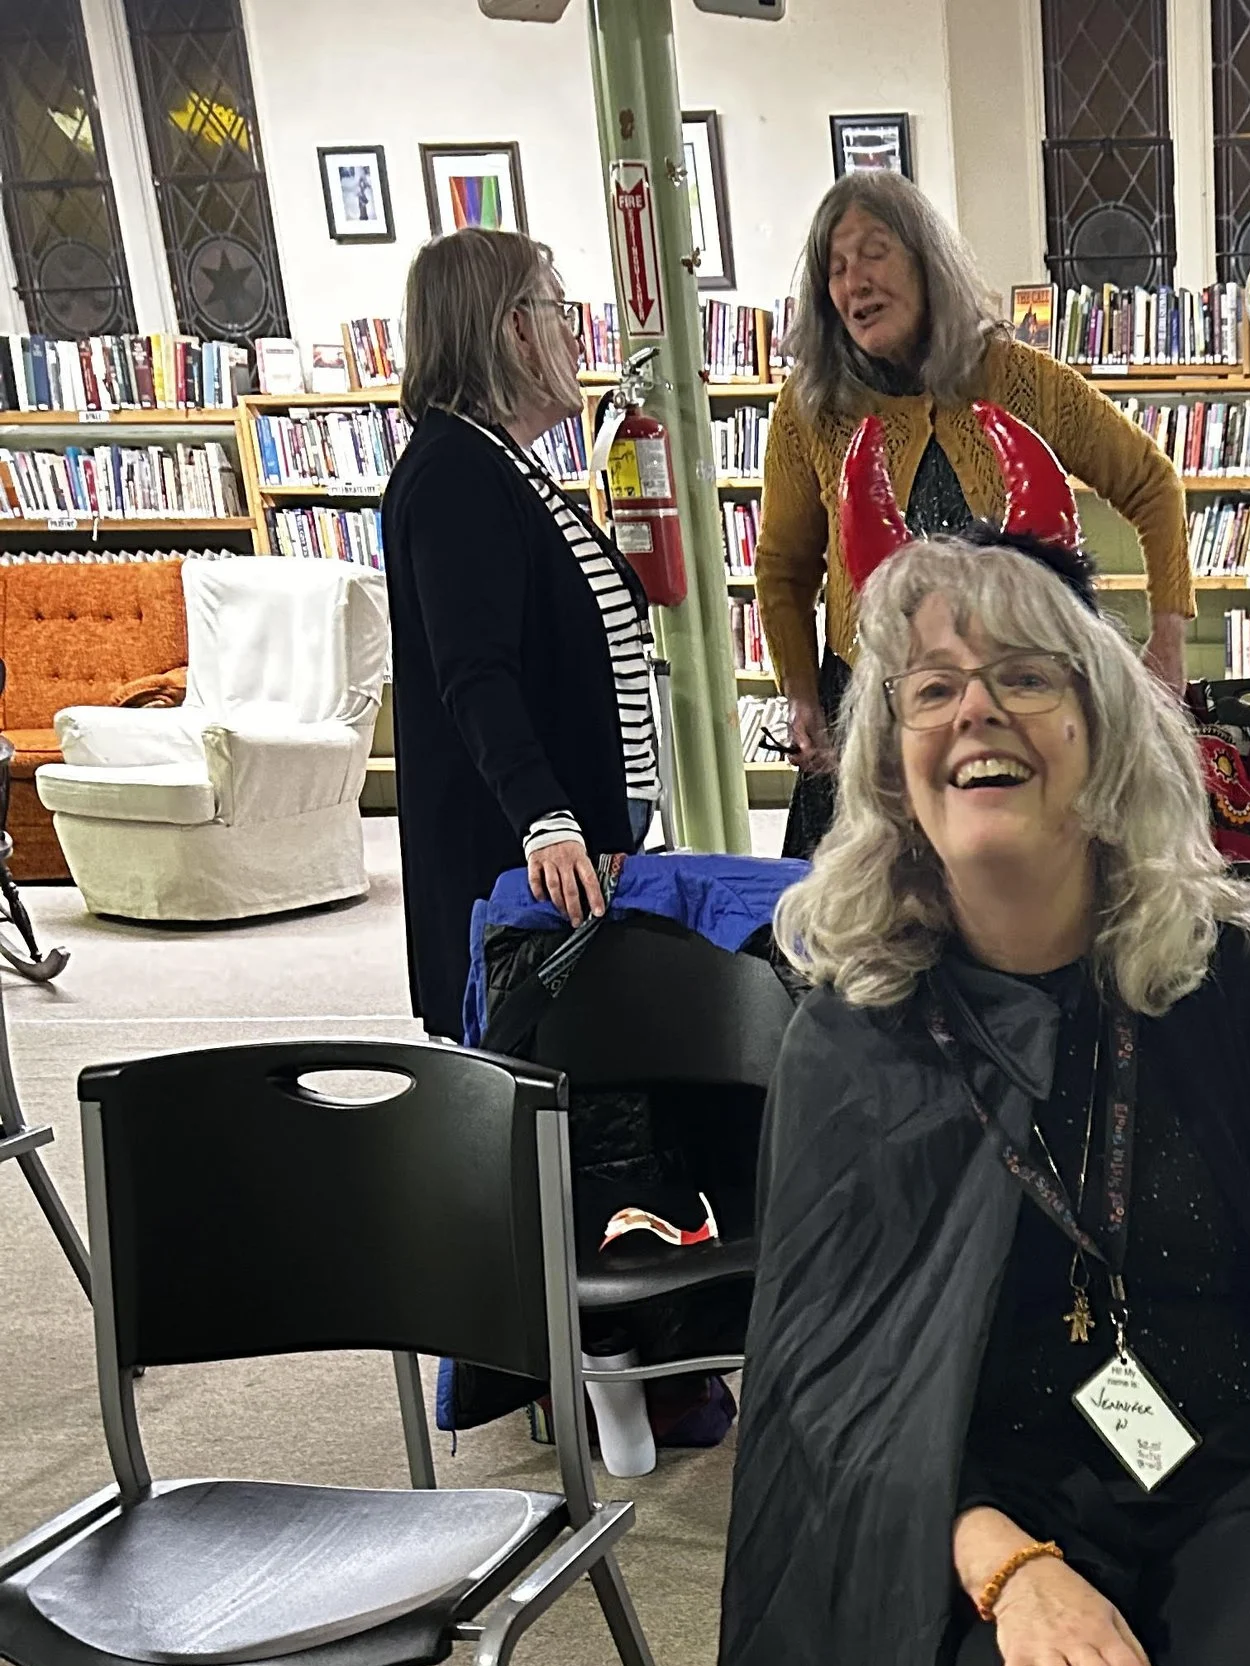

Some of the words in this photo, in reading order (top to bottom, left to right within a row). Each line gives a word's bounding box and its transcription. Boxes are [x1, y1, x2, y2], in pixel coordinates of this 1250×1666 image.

[618, 194, 643, 209] FIRE
[1124, 1367, 1136, 1379] My
[1107, 1378, 1129, 1388] name
